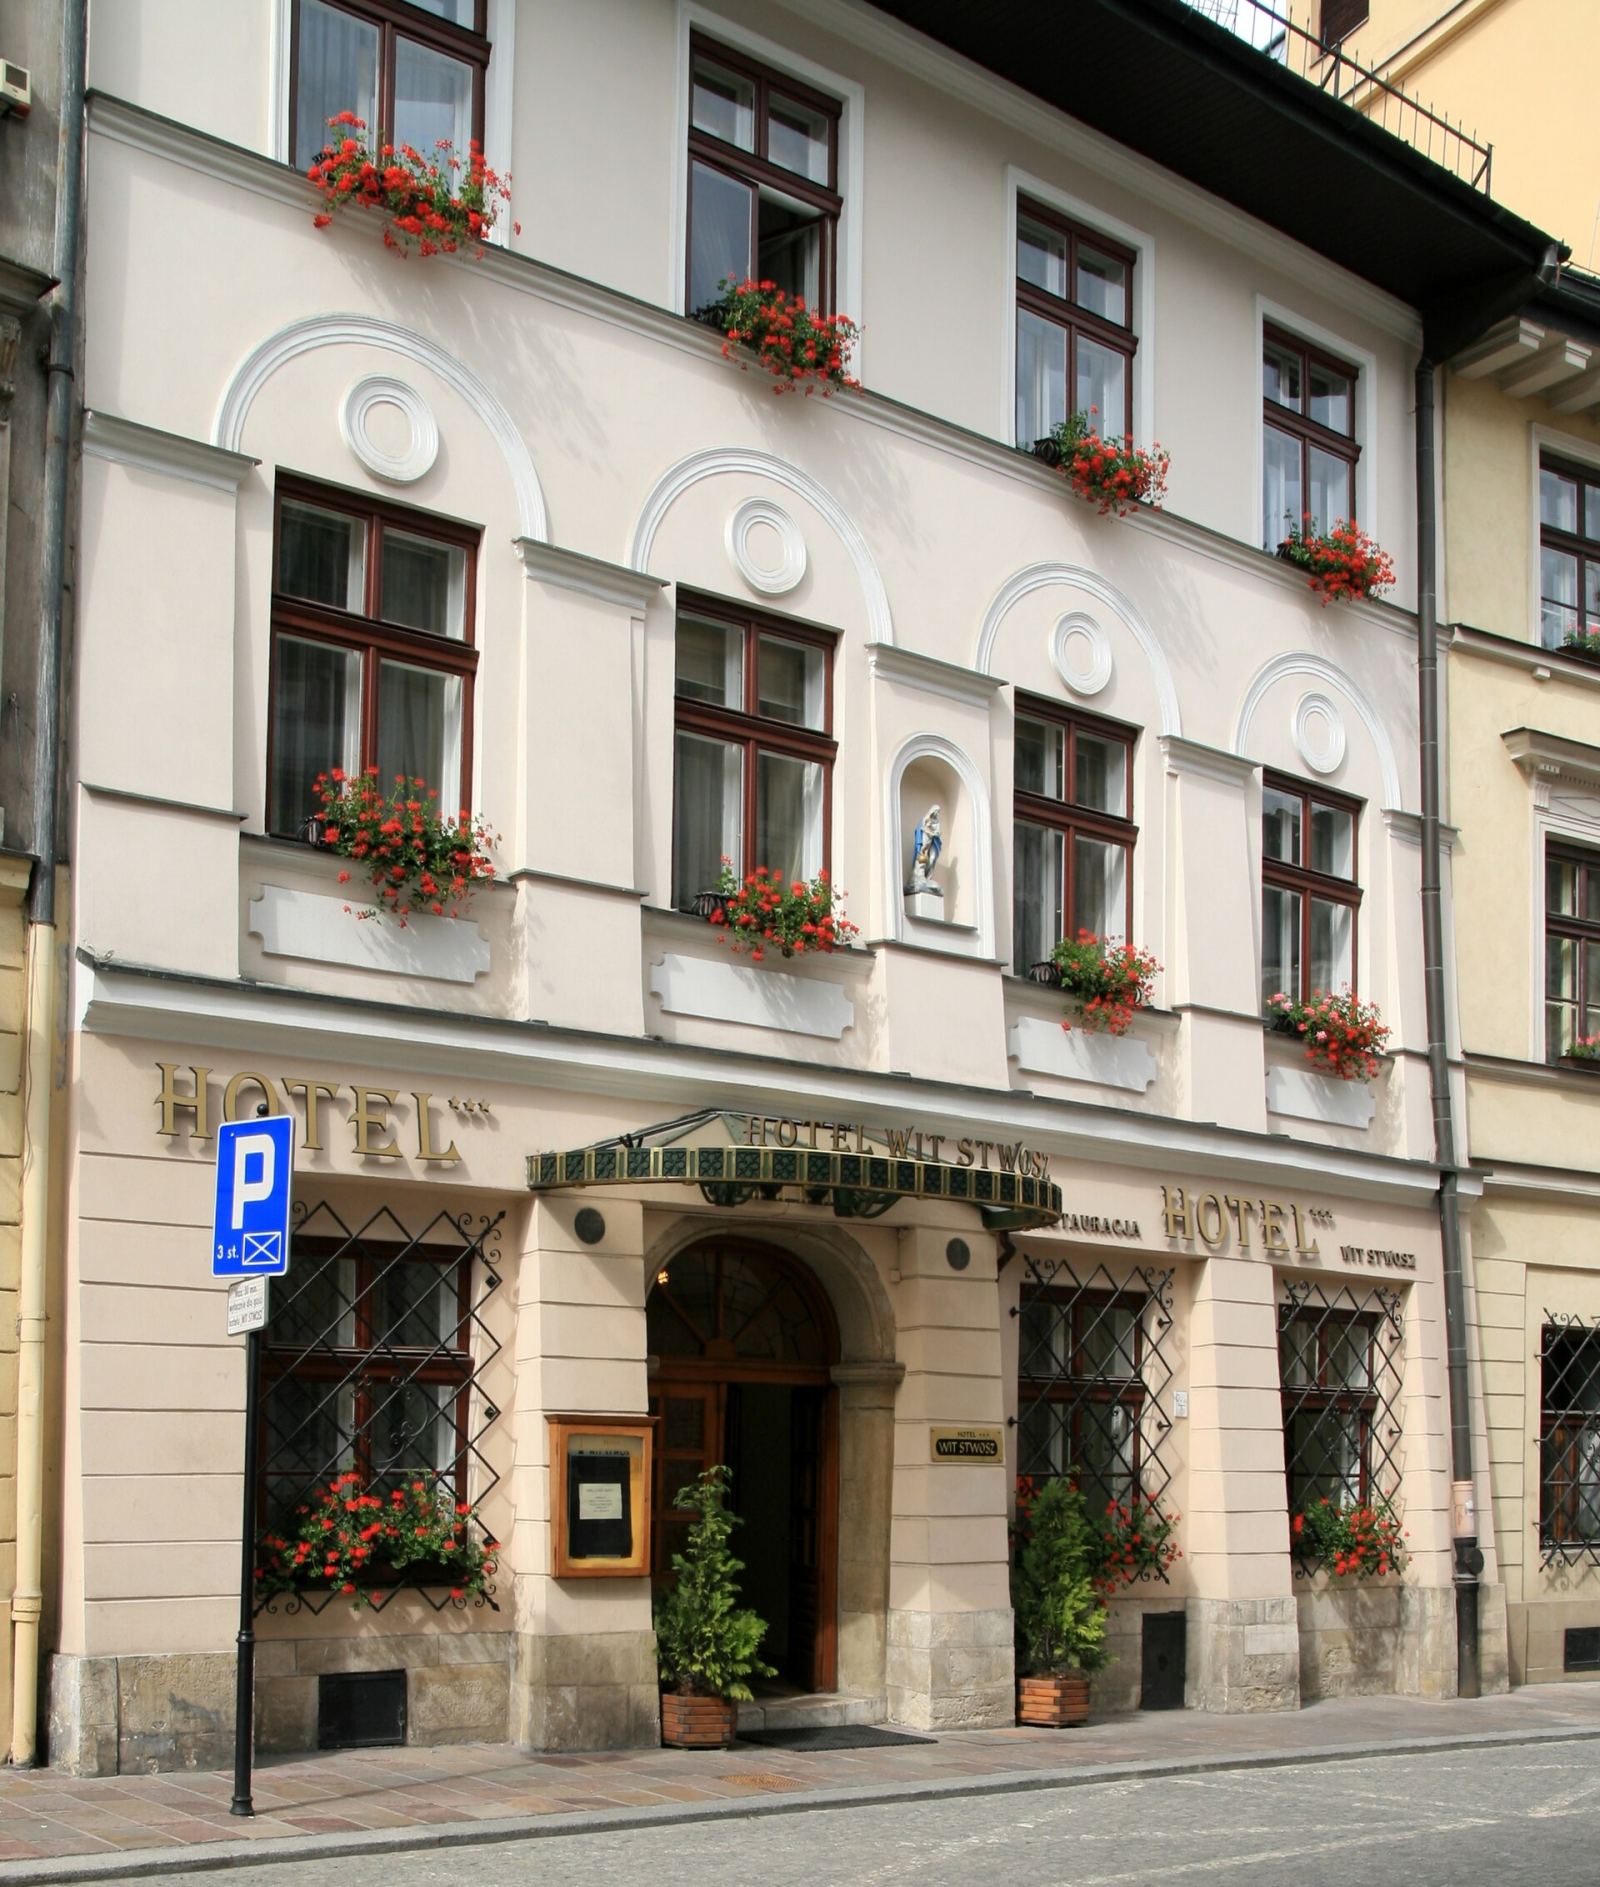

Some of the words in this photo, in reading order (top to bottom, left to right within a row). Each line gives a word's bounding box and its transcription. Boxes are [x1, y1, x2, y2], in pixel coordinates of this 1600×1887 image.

[155, 1062, 462, 1161] HOTEL
[743, 1115, 874, 1155] HOTEL
[885, 1125, 946, 1164] WIT
[956, 1137, 1051, 1181] STWOSZ
[231, 1133, 276, 1230] P
[1055, 1212, 1141, 1238] TAURACJA
[1160, 1185, 1320, 1254] HOTEL
[216, 1244, 224, 1260] 3
[227, 1244, 240, 1260] st.
[1340, 1245, 1364, 1263] WIT
[1366, 1249, 1417, 1270] STWOSZ
[938, 1441, 958, 1454] WIT
[959, 1441, 996, 1455] STWOSZ
